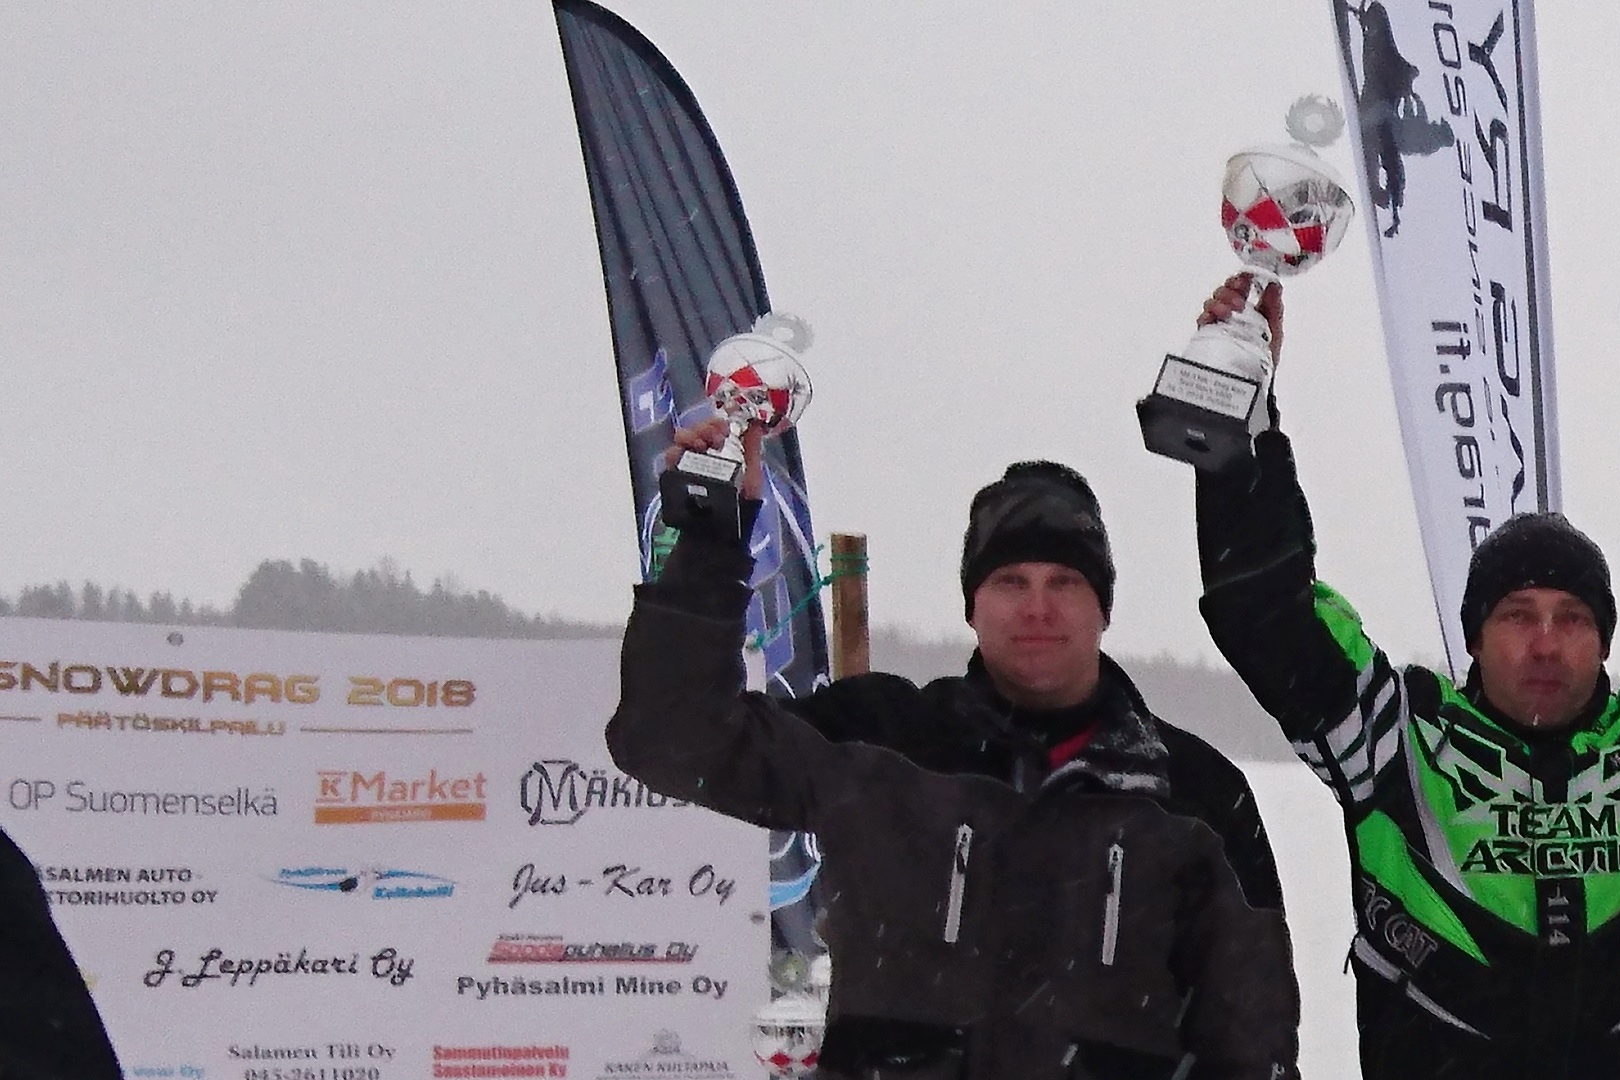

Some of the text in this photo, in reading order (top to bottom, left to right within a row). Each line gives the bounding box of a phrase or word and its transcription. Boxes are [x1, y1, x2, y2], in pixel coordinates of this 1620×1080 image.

[347, 676, 476, 708] 2018
[9, 778, 278, 816] OP Suomenselkä
[1488, 803, 1619, 839] TEAM
[191, 890, 219, 905] OY
[688, 864, 737, 907] Oy
[181, 947, 359, 988] Leppäkari
[370, 947, 415, 987] Oy
[456, 974, 728, 1000] Pyhäsalmi Mine Oy
